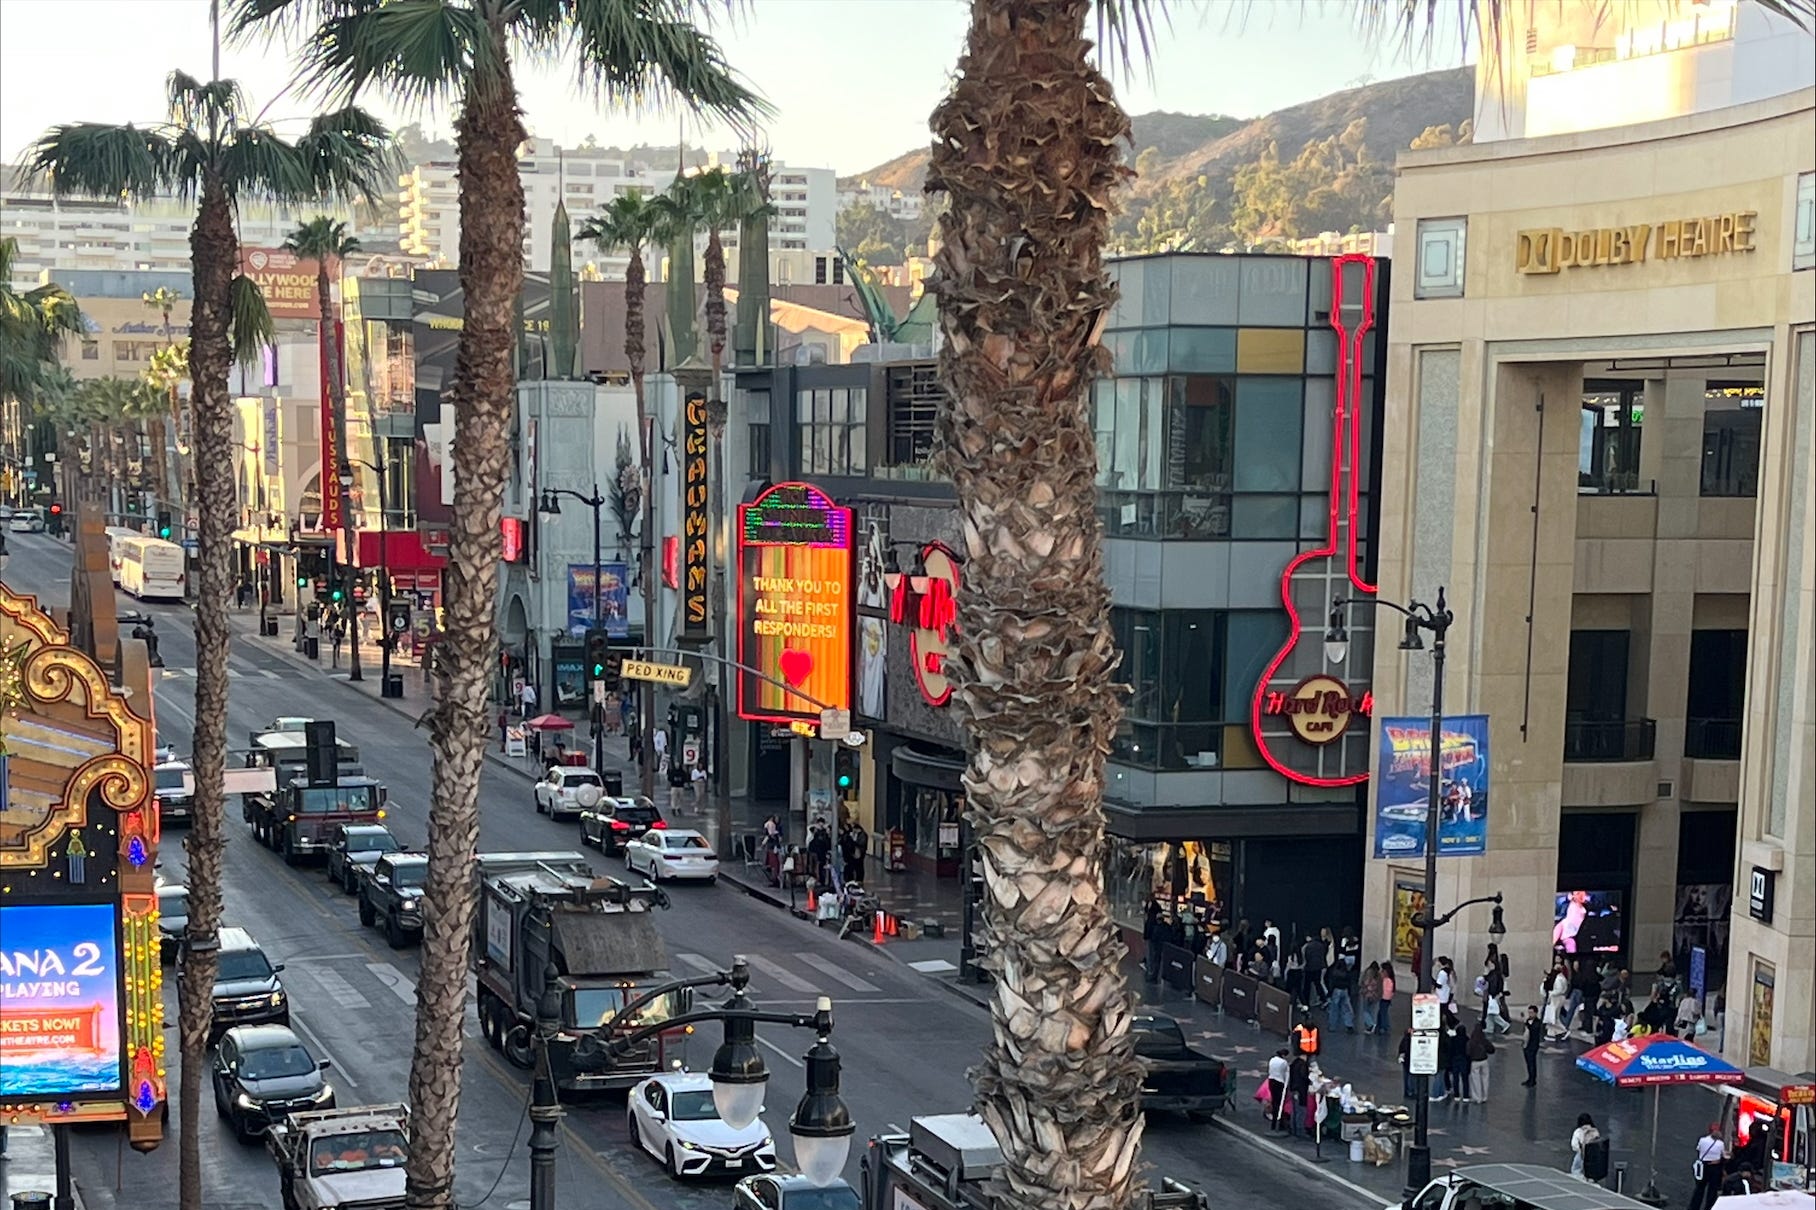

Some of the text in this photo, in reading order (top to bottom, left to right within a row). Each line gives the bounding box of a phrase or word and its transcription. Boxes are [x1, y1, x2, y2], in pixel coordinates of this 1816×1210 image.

[1556, 225, 1651, 268] DOLBY
[275, 287, 311, 299] HERE
[753, 577, 842, 595] THANK YOU TO
[755, 599, 839, 617] ALL THE FIRST
[754, 620, 837, 638] RESPONDERS!
[557, 663, 584, 672] IMAX
[626, 663, 685, 682] PED XING
[71, 942, 105, 977] 2
[0, 1019, 39, 1033] KETS
